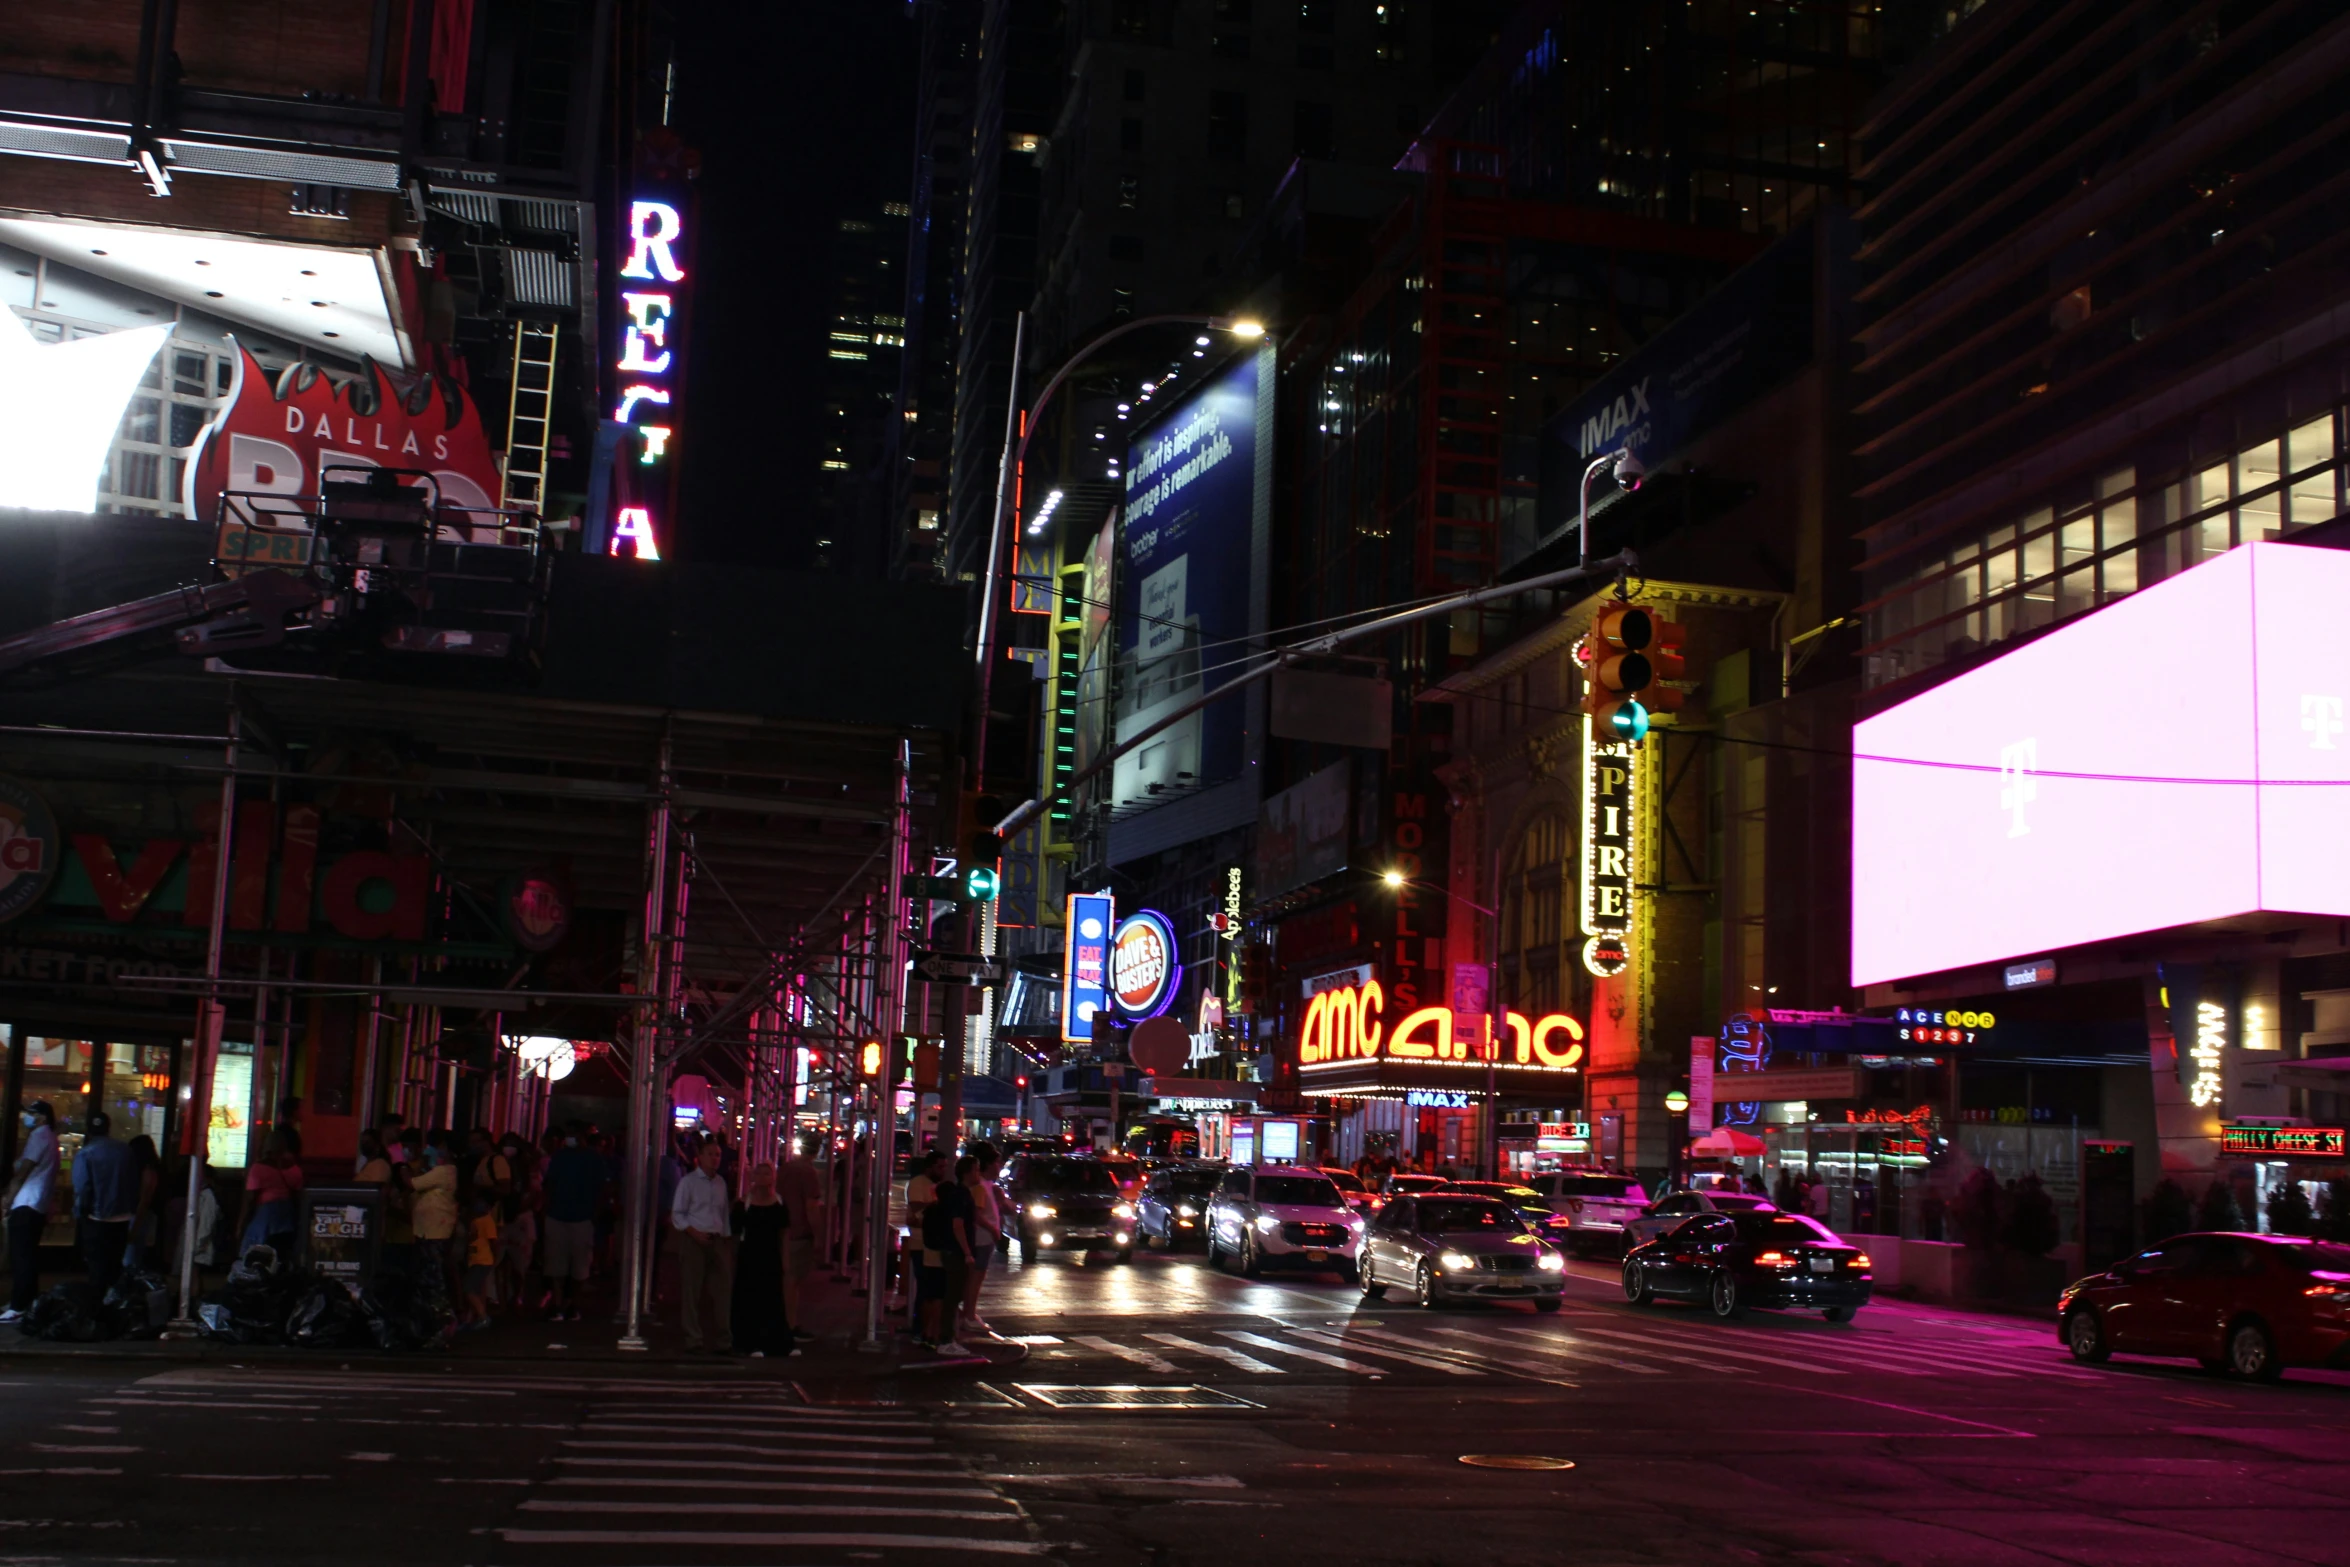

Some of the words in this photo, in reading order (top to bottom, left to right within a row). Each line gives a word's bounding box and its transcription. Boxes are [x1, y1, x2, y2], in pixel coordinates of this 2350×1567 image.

[286, 405, 448, 461] DALLAS
[1580, 375, 1650, 460] IMAX
[1137, 440, 1163, 483] effort
[1164, 435, 1173, 464] is
[1174, 406, 1220, 456] inspiring.
[1161, 472, 1170, 501] is
[1171, 430, 1232, 494] remarkable.
[1131, 527, 1159, 559] brother
[70, 800, 430, 941] villa
[916, 879, 927, 897] 8
[511, 887, 565, 924] villa
[1221, 867, 1242, 942] Applebee's
[927, 961, 954, 974] ONE
[967, 963, 995, 977] WAY
[1115, 936, 1147, 974] DAVE
[1148, 934, 1161, 958] &
[1595, 949, 1624, 960] amc
[1115, 958, 1163, 994] BUSTER'S
[2007, 968, 2036, 986] branded
[1301, 980, 1383, 1062] amc
[1408, 1091, 1468, 1109] IMAX
[2223, 1129, 2268, 1149] PHILLY
[2272, 1130, 2320, 1150] CHEESE
